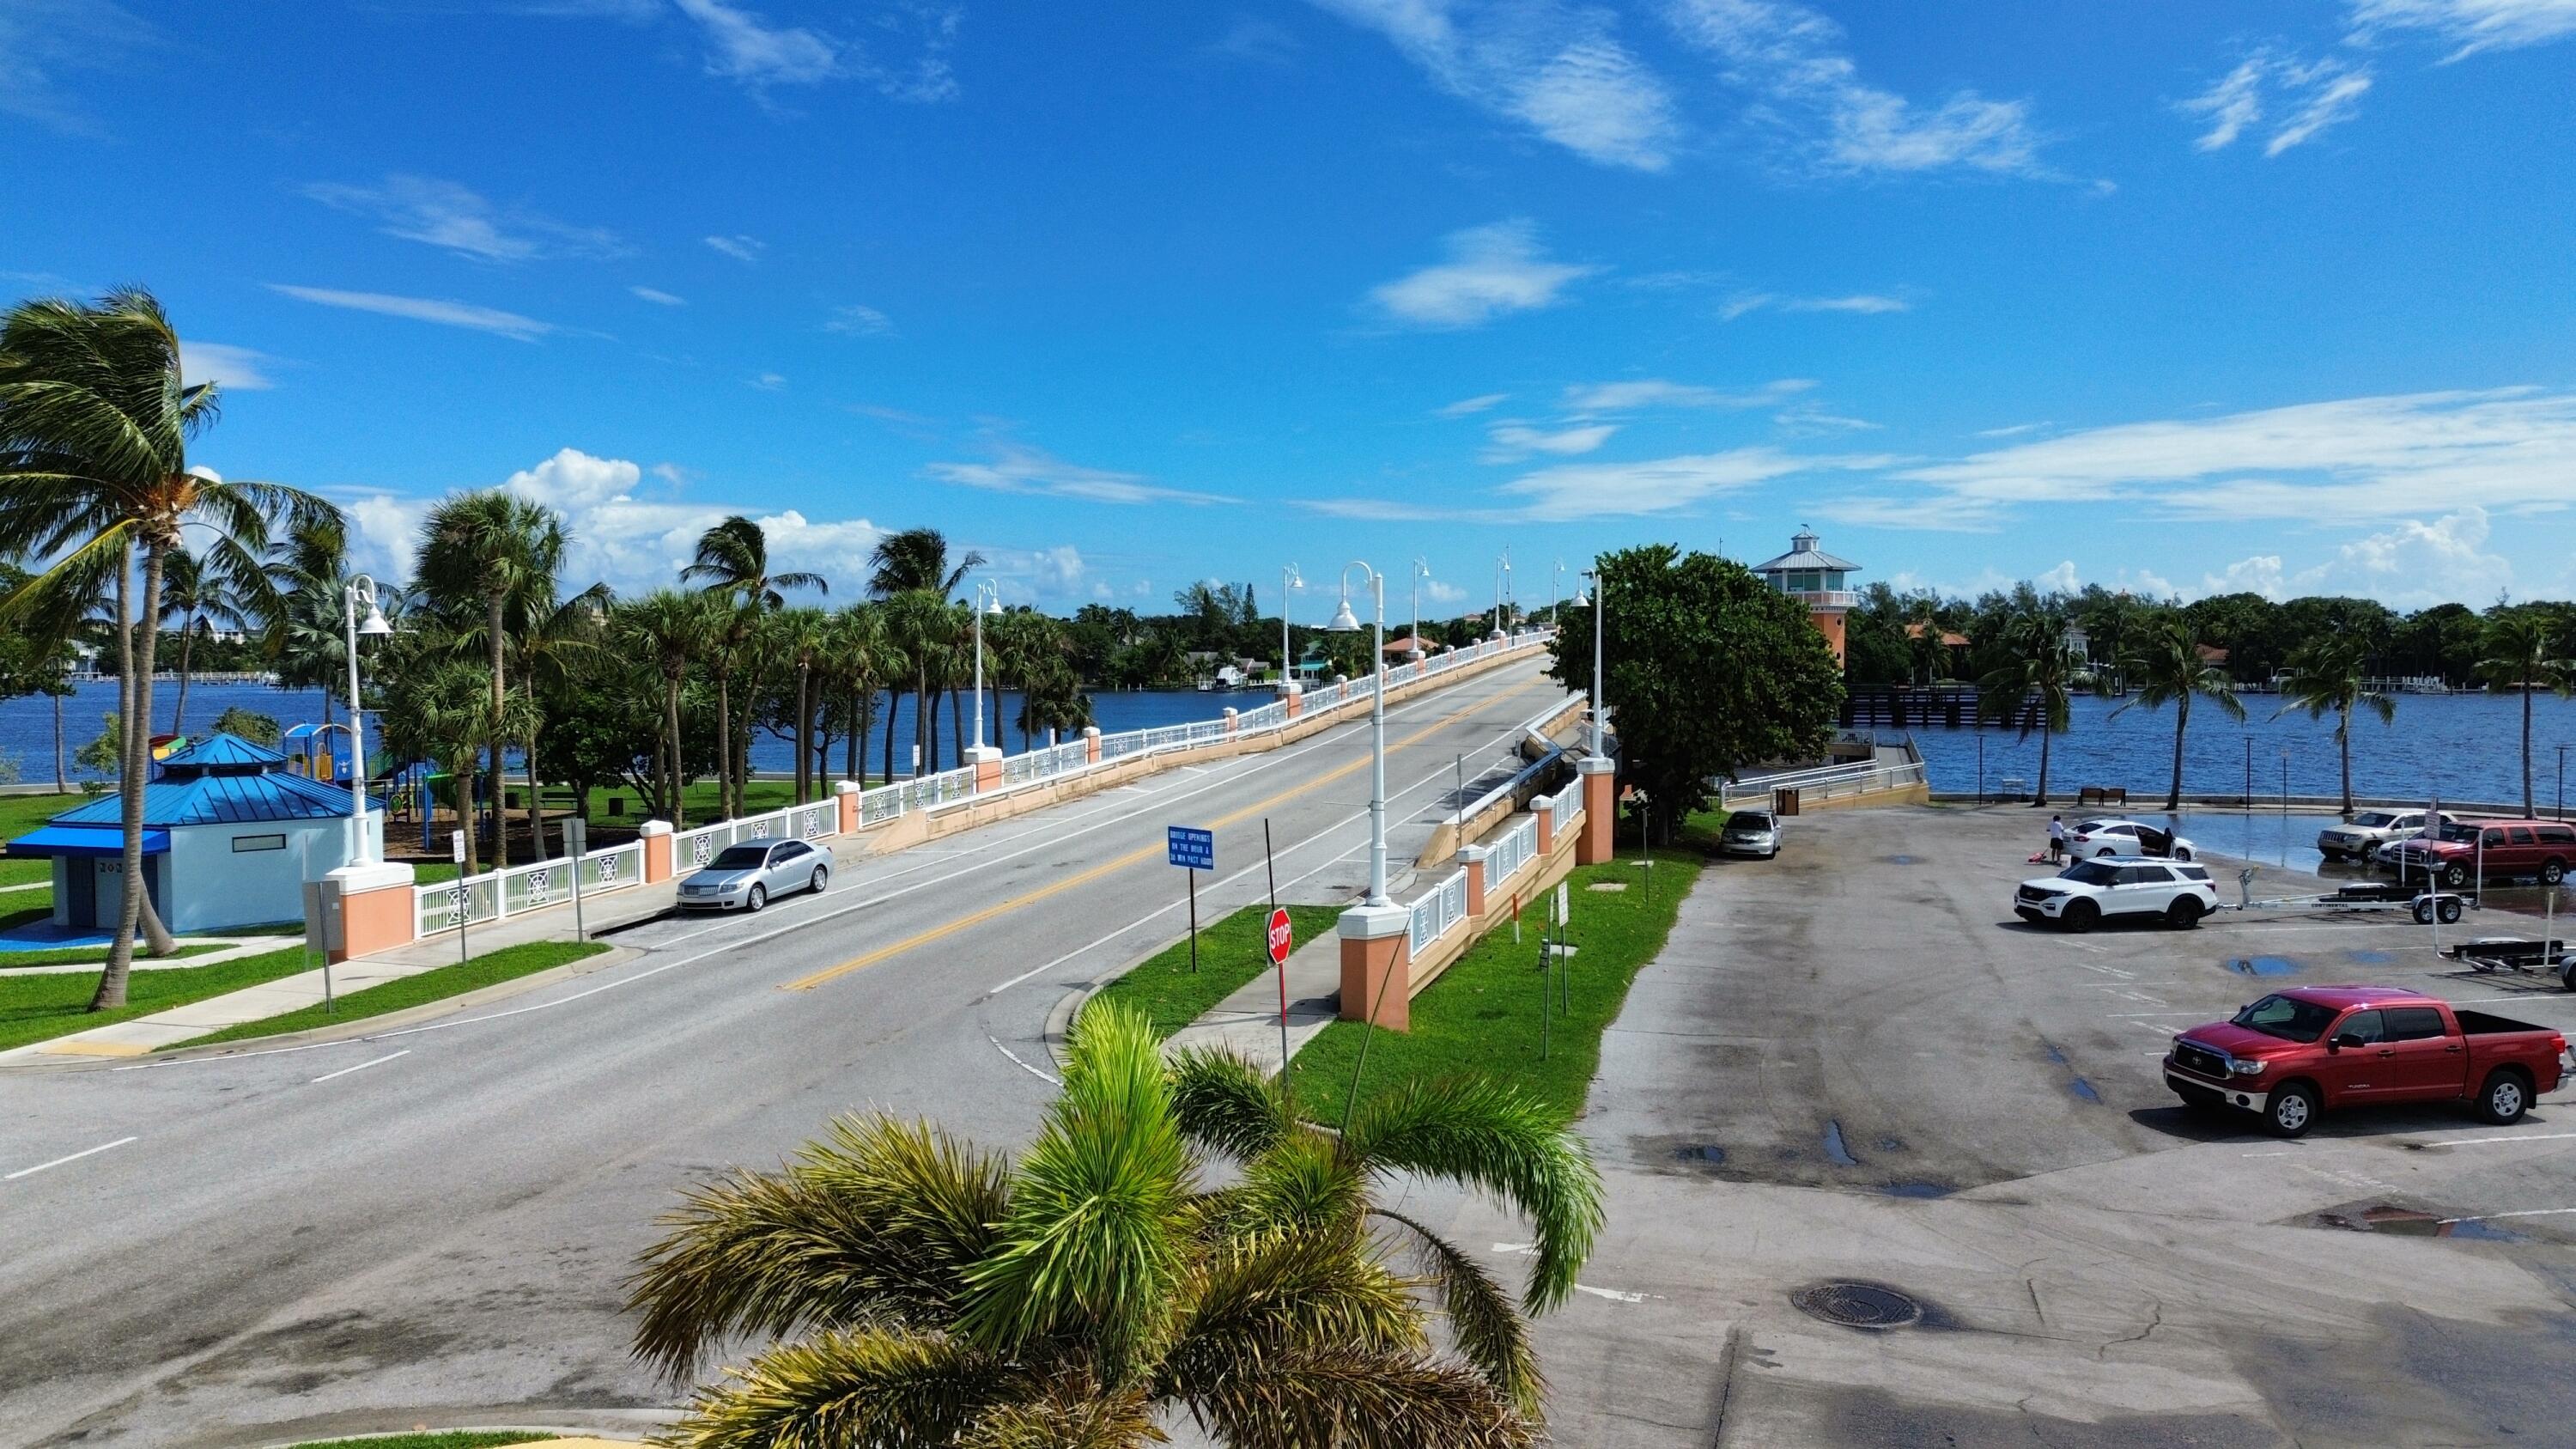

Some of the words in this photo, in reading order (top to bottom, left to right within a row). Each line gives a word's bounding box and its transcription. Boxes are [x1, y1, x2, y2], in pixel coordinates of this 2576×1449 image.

[1170, 831, 1186, 840] BRIDGE
[1188, 832, 1211, 843] OPENINGS
[1171, 842, 1178, 850] ON
[1180, 843, 1189, 852] THE
[1190, 845, 1203, 854] HOUR
[1177, 854, 1186, 862] MIN
[1187, 855, 1199, 864] PAST
[1271, 923, 1290, 950] STOP
